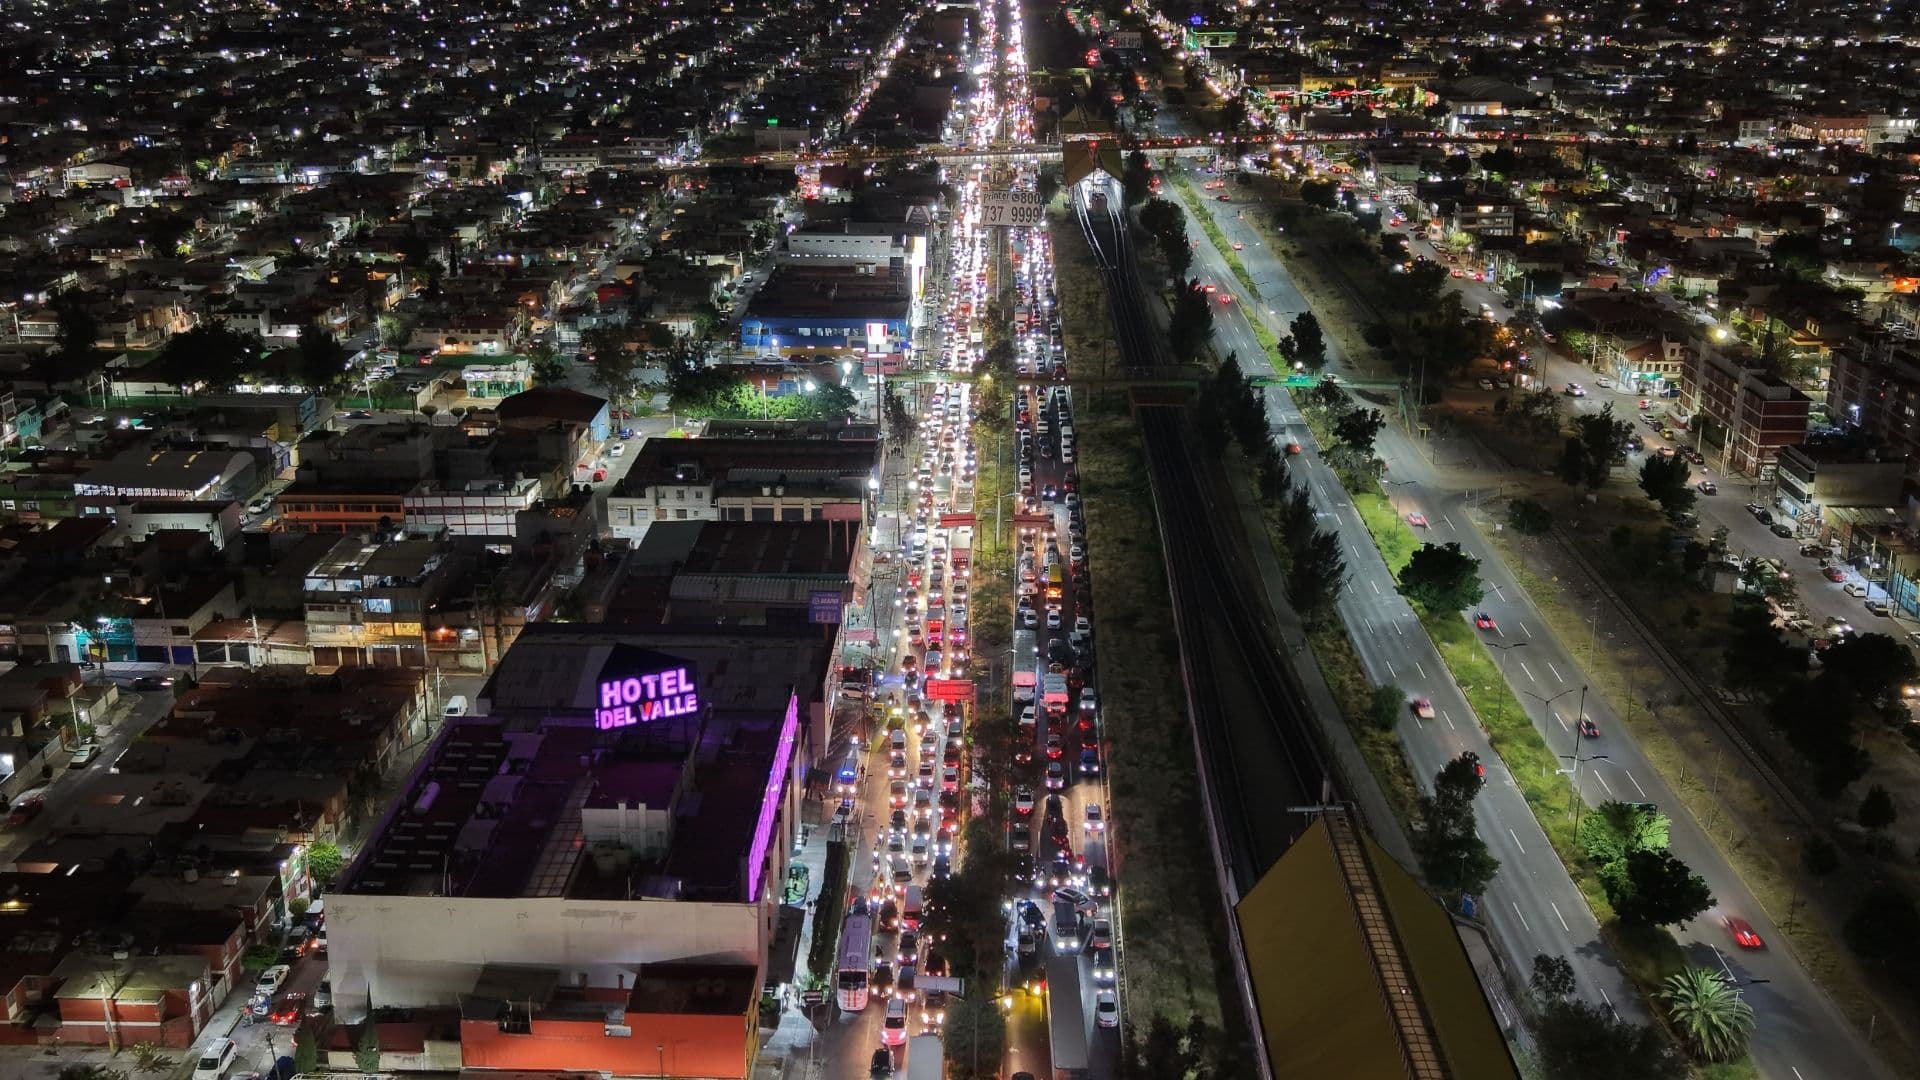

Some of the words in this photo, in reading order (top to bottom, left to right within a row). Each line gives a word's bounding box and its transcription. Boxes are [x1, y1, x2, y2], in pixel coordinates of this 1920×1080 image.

[1020, 192, 1041, 204] 800
[983, 205, 1005, 222] 737
[1011, 206, 1040, 223] 9999
[601, 668, 694, 708] HOTEL
[600, 706, 637, 730] DEL
[638, 693, 698, 722] VALLE
